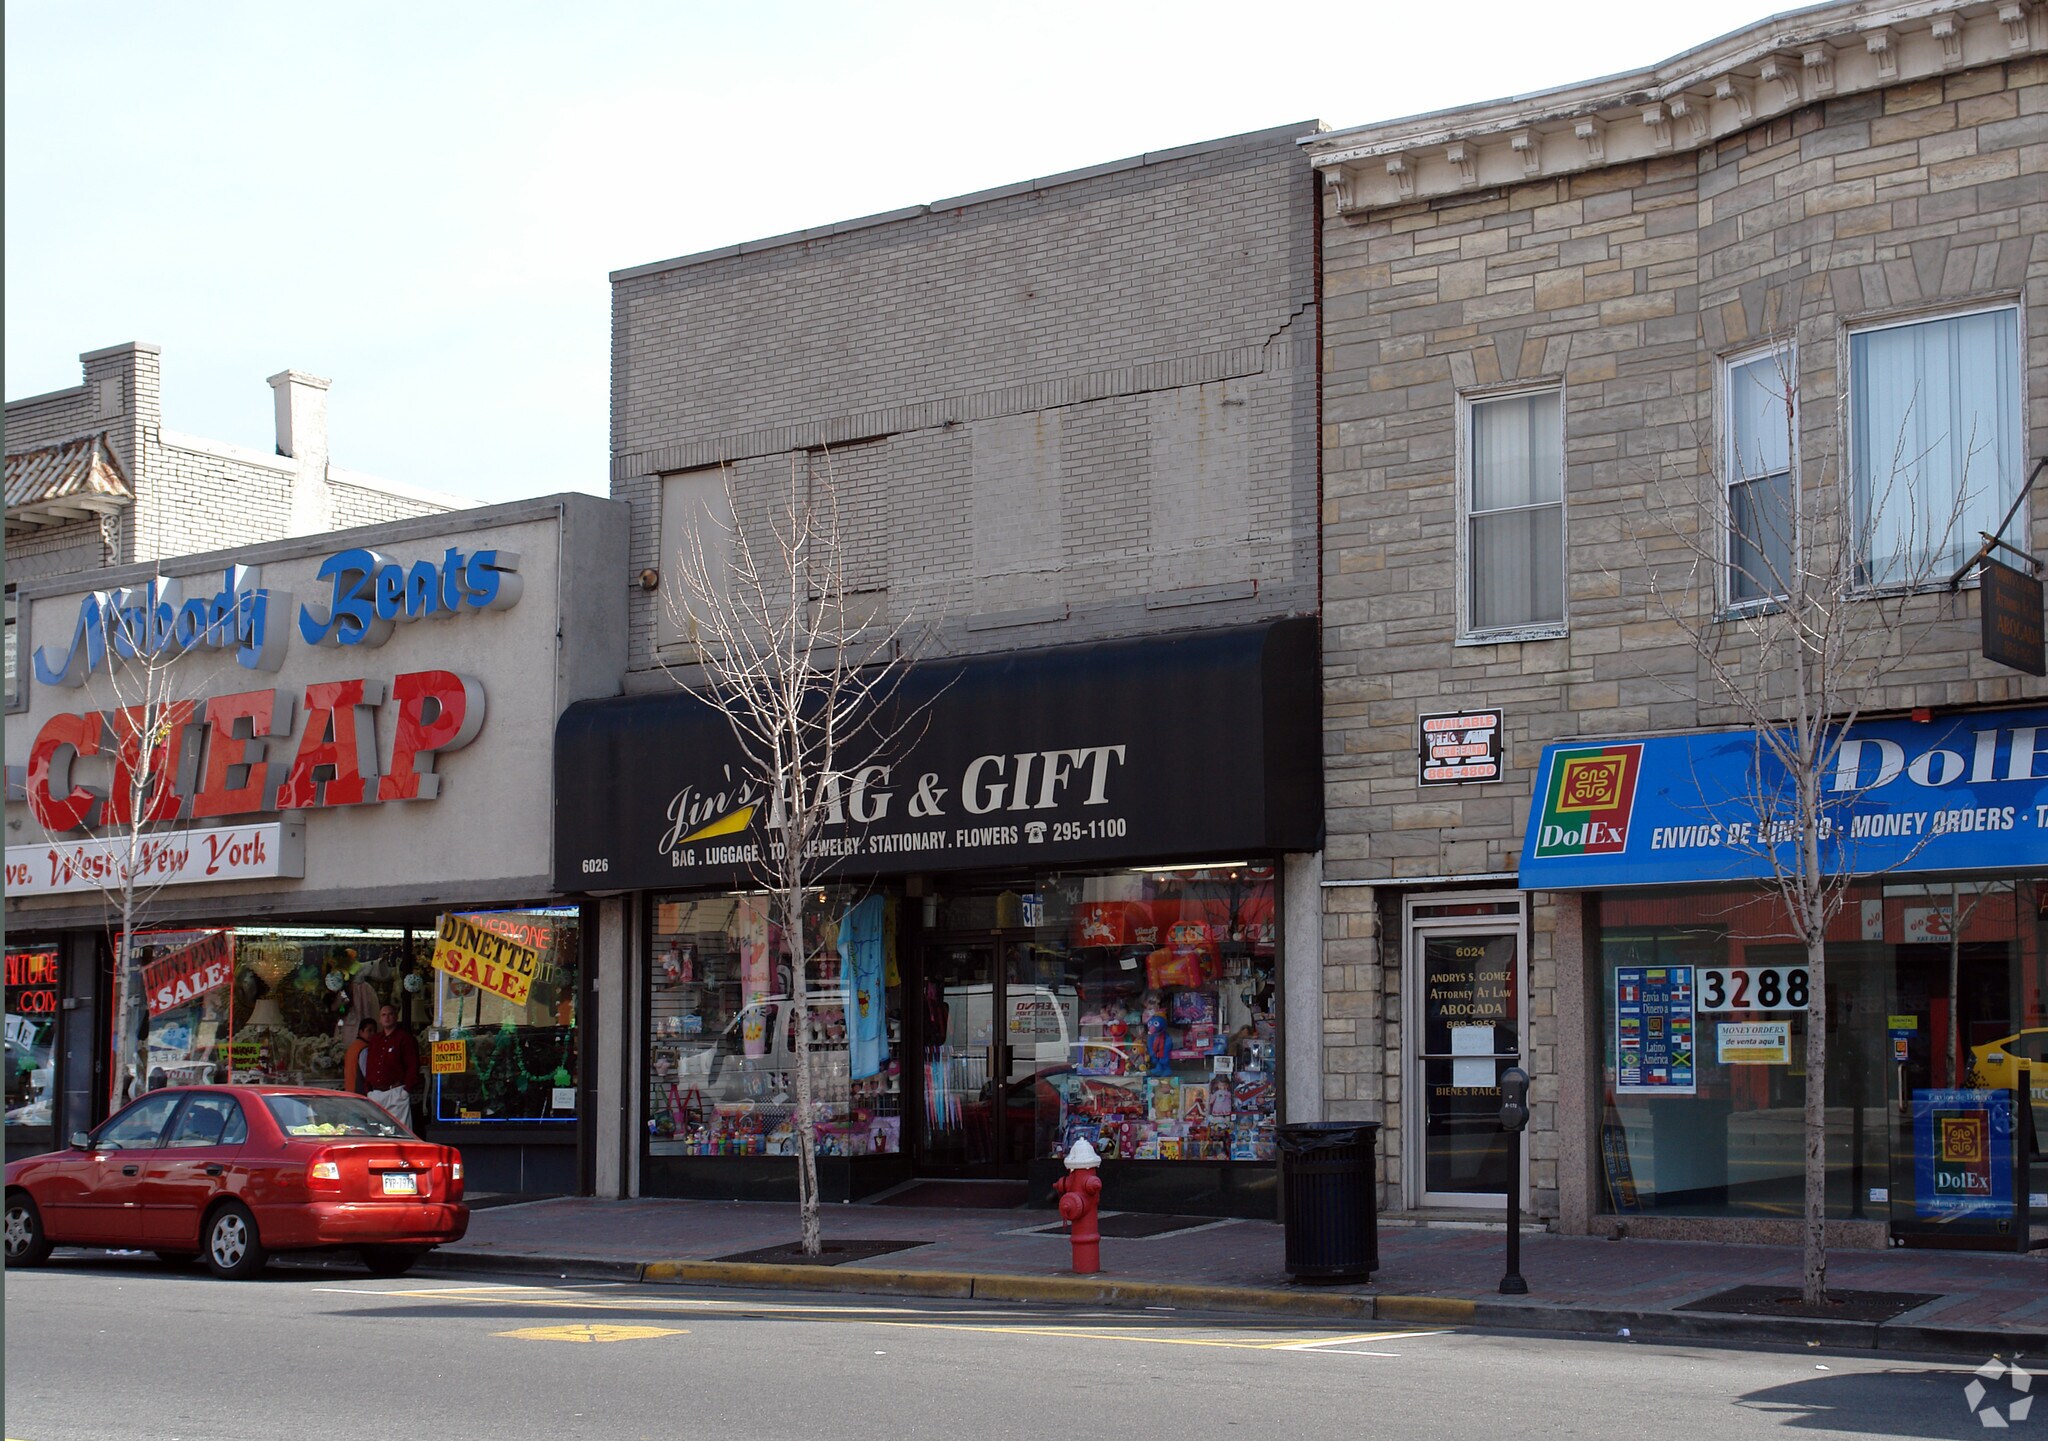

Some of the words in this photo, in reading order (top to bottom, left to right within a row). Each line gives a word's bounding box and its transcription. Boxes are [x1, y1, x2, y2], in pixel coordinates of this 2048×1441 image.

[33, 563, 282, 686] Nobody
[299, 547, 512, 645] Beats
[1426, 715, 1494, 731] AVAILABLE
[27, 670, 477, 831] CHEAP
[1427, 764, 1495, 779] 866-4800
[908, 773, 948, 817] &
[962, 745, 1126, 815] GIFT
[659, 764, 758, 855] Jin's
[1540, 822, 1625, 848] DolEx
[1651, 824, 1722, 850] ENVIOS
[1726, 822, 1751, 845] DE
[1851, 812, 1928, 838] MONEY
[1932, 806, 2015, 834] ORDERS
[672, 850, 695, 867] BAG
[706, 844, 759, 865] LUGGAGE
[769, 842, 790, 861] TO
[804, 837, 861, 858] JEWELRY
[870, 831, 946, 854] STATIONARY
[957, 825, 1018, 848] FLOWERS
[1053, 818, 1127, 842] 295-1100
[48, 847, 111, 886] West
[121, 840, 189, 880] New
[202, 831, 266, 876] York
[582, 858, 608, 873] 6026
[440, 916, 535, 977] DINETTE
[1456, 947, 1485, 957] 6024
[444, 949, 520, 999] SALE
[1430, 973, 1466, 983] ANDRYS
[1468, 972, 1476, 982] S.
[1479, 971, 1512, 982] GOMEZ
[157, 963, 224, 1010] SALE
[1704, 968, 1809, 1008] 3288
[1661, 992, 1669, 1002] tu
[1440, 1004, 1502, 1016] ABOGADA
[1643, 1003, 1664, 1014] Dinero
[1664, 1006, 1669, 1014] a
[1752, 1026, 1785, 1034] ORDERS
[436, 1042, 462, 1053] MORE
[1646, 1042, 1666, 1053] Latino
[435, 1053, 463, 1063] DINETTES
[1436, 1087, 1468, 1096] BIENES
[1471, 1086, 1502, 1096] RAICE
[1938, 1172, 1989, 1190] DolEx
